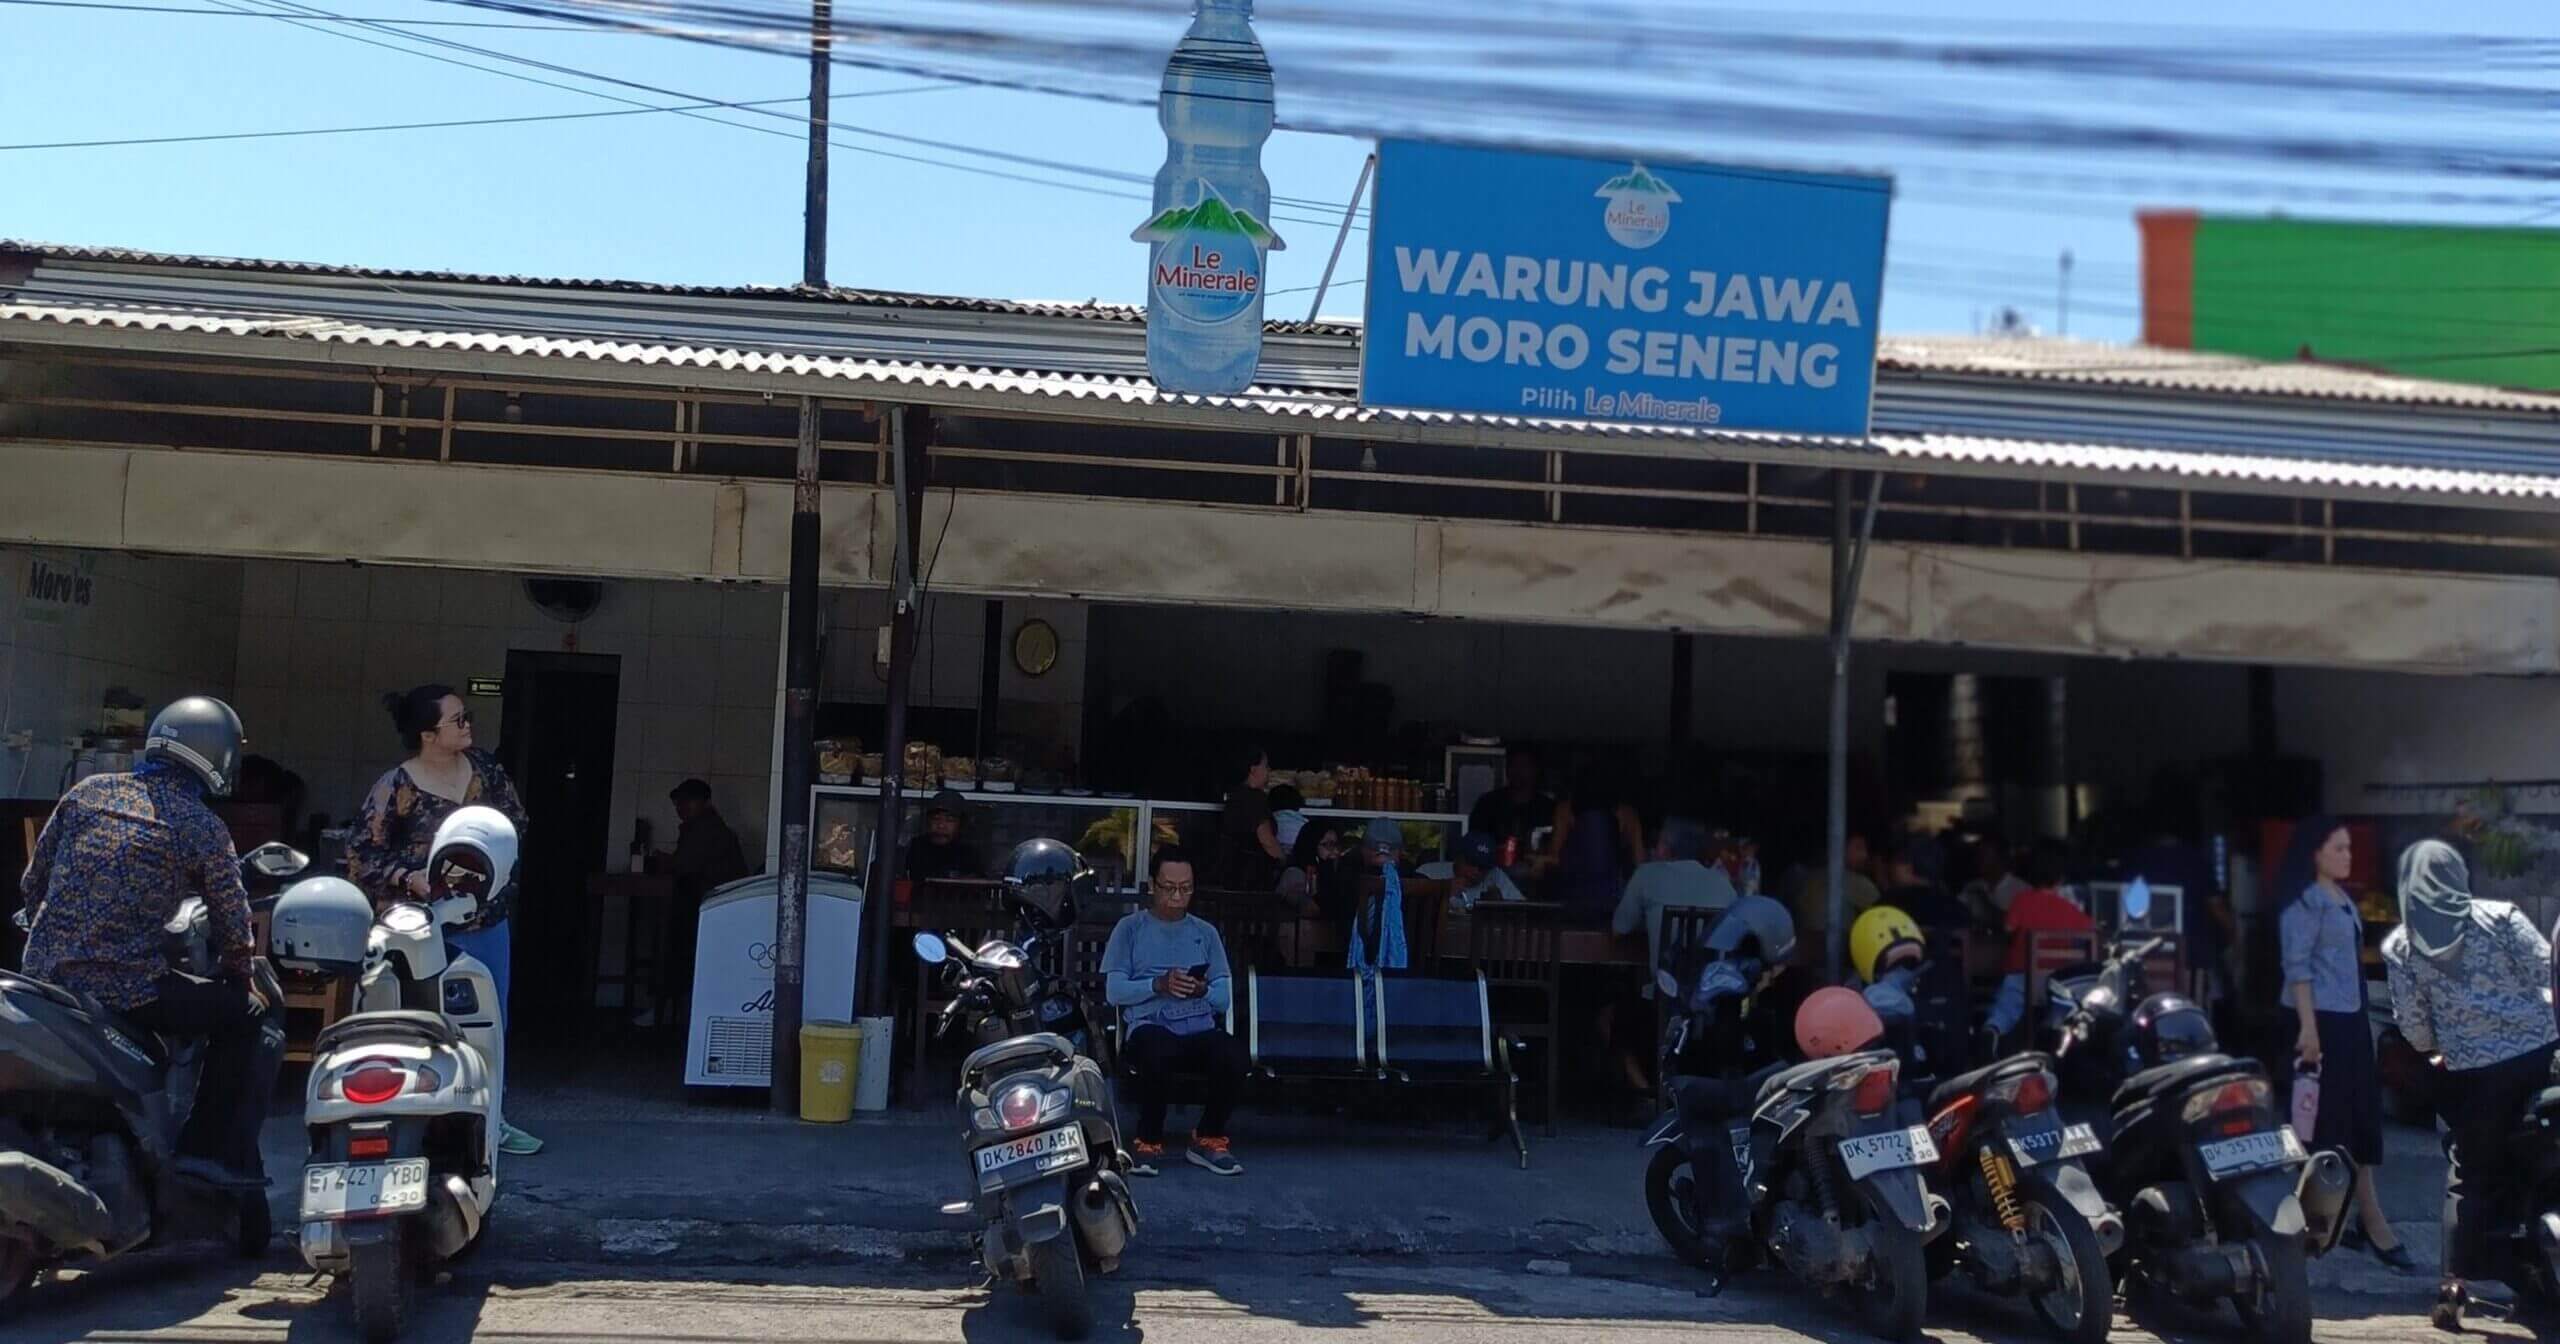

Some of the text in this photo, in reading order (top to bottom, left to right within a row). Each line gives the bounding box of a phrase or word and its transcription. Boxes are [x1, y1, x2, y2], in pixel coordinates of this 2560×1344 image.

[1629, 199, 1646, 215] Le
[1192, 244, 1222, 270] Le
[1156, 263, 1258, 293] Minerale
[1395, 246, 1861, 328] WARUNG JAWA
[1405, 311, 1841, 389] MORO SENENG
[1521, 385, 1721, 423] Pilih Le Minerale
[983, 1130, 1079, 1169] DK 2840 ABK
[1843, 1140, 1865, 1159] DK
[1868, 1134, 1904, 1152] 5772
